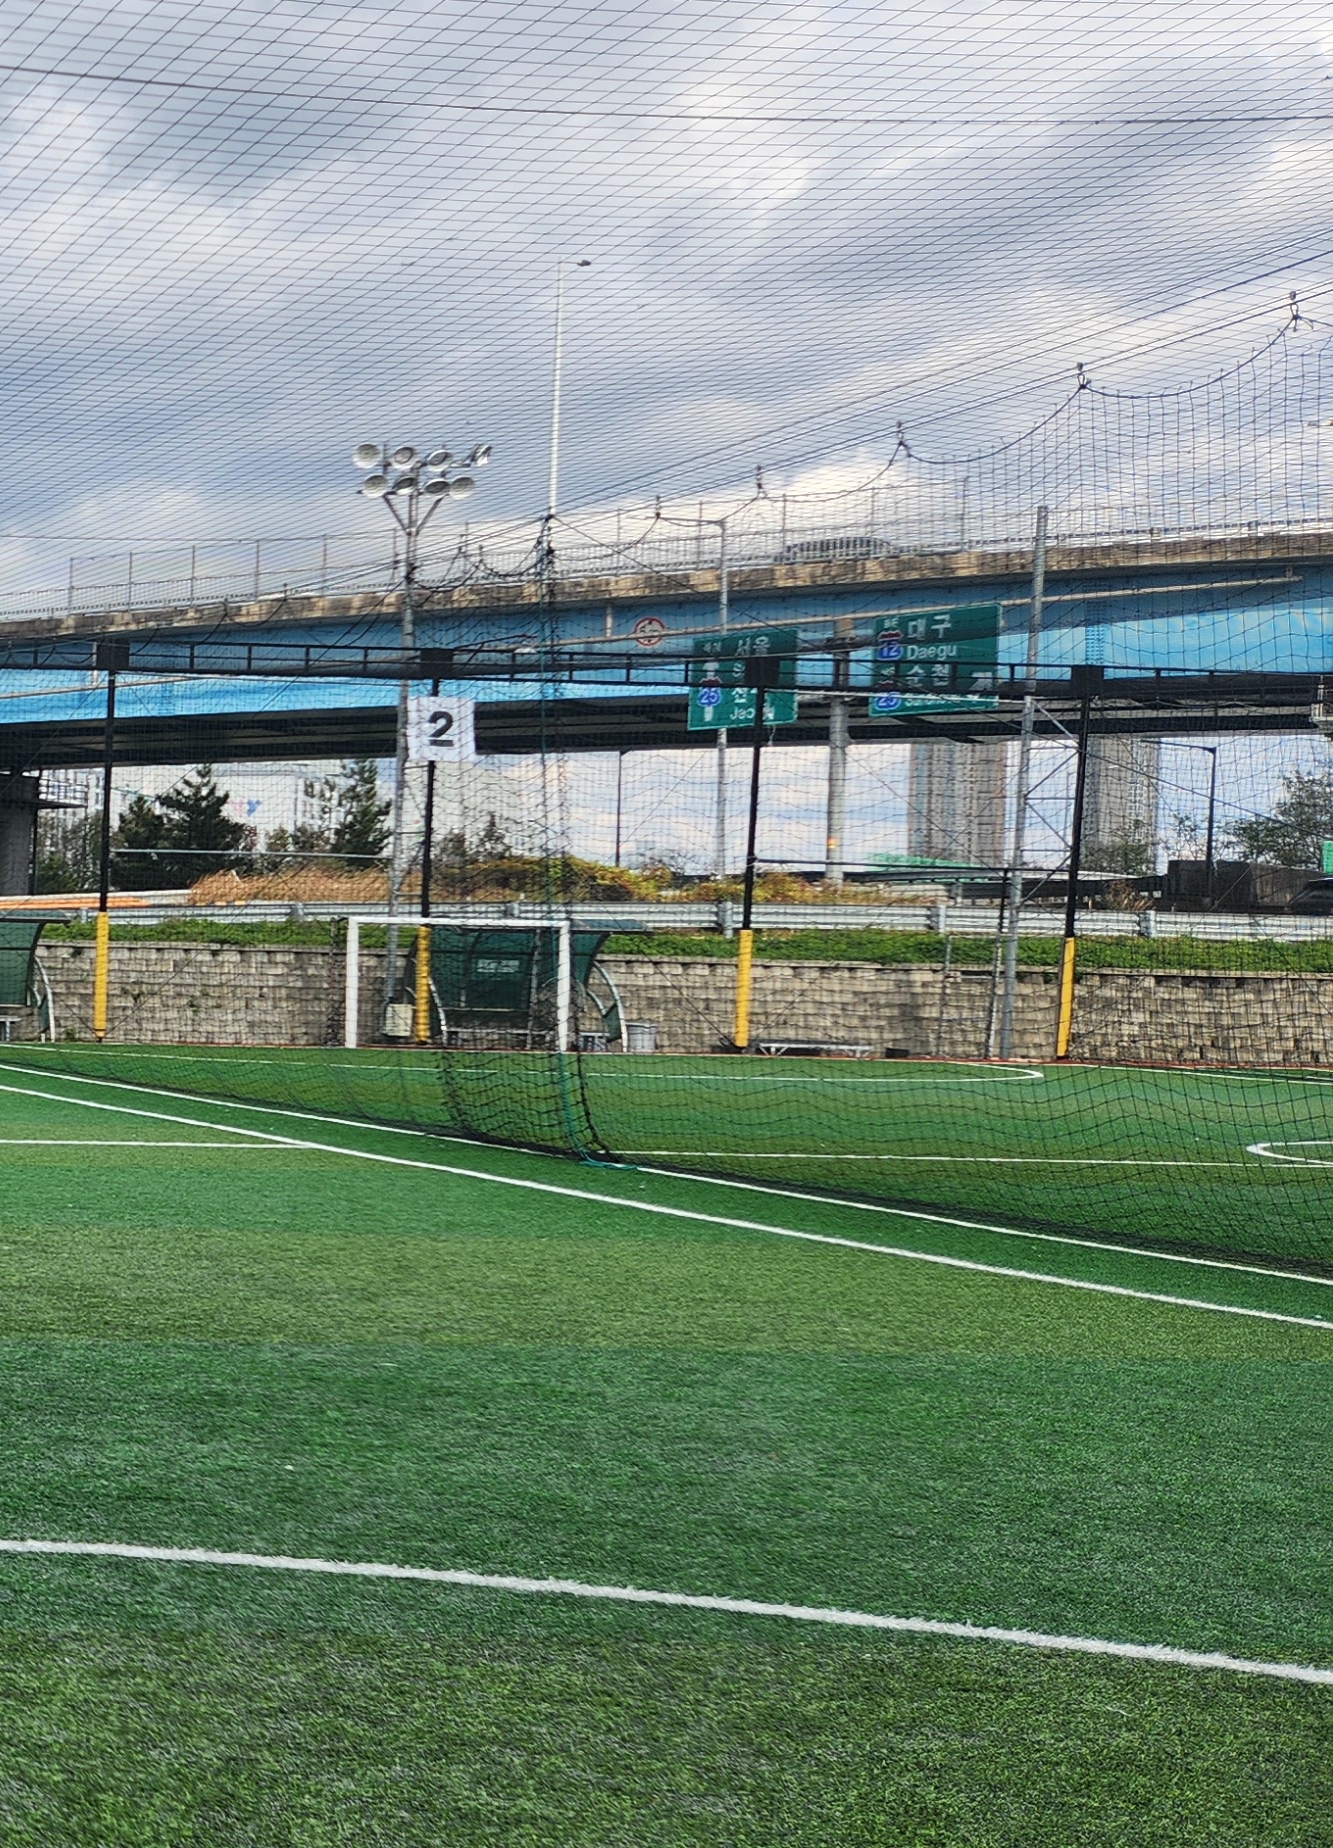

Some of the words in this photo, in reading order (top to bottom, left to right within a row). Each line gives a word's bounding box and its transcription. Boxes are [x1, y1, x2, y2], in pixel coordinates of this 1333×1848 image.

[907, 614, 952, 639] 대구
[883, 645, 899, 657] 12
[906, 644, 958, 661] Daegu
[699, 687, 720, 704] 25
[428, 710, 454, 747] 2
